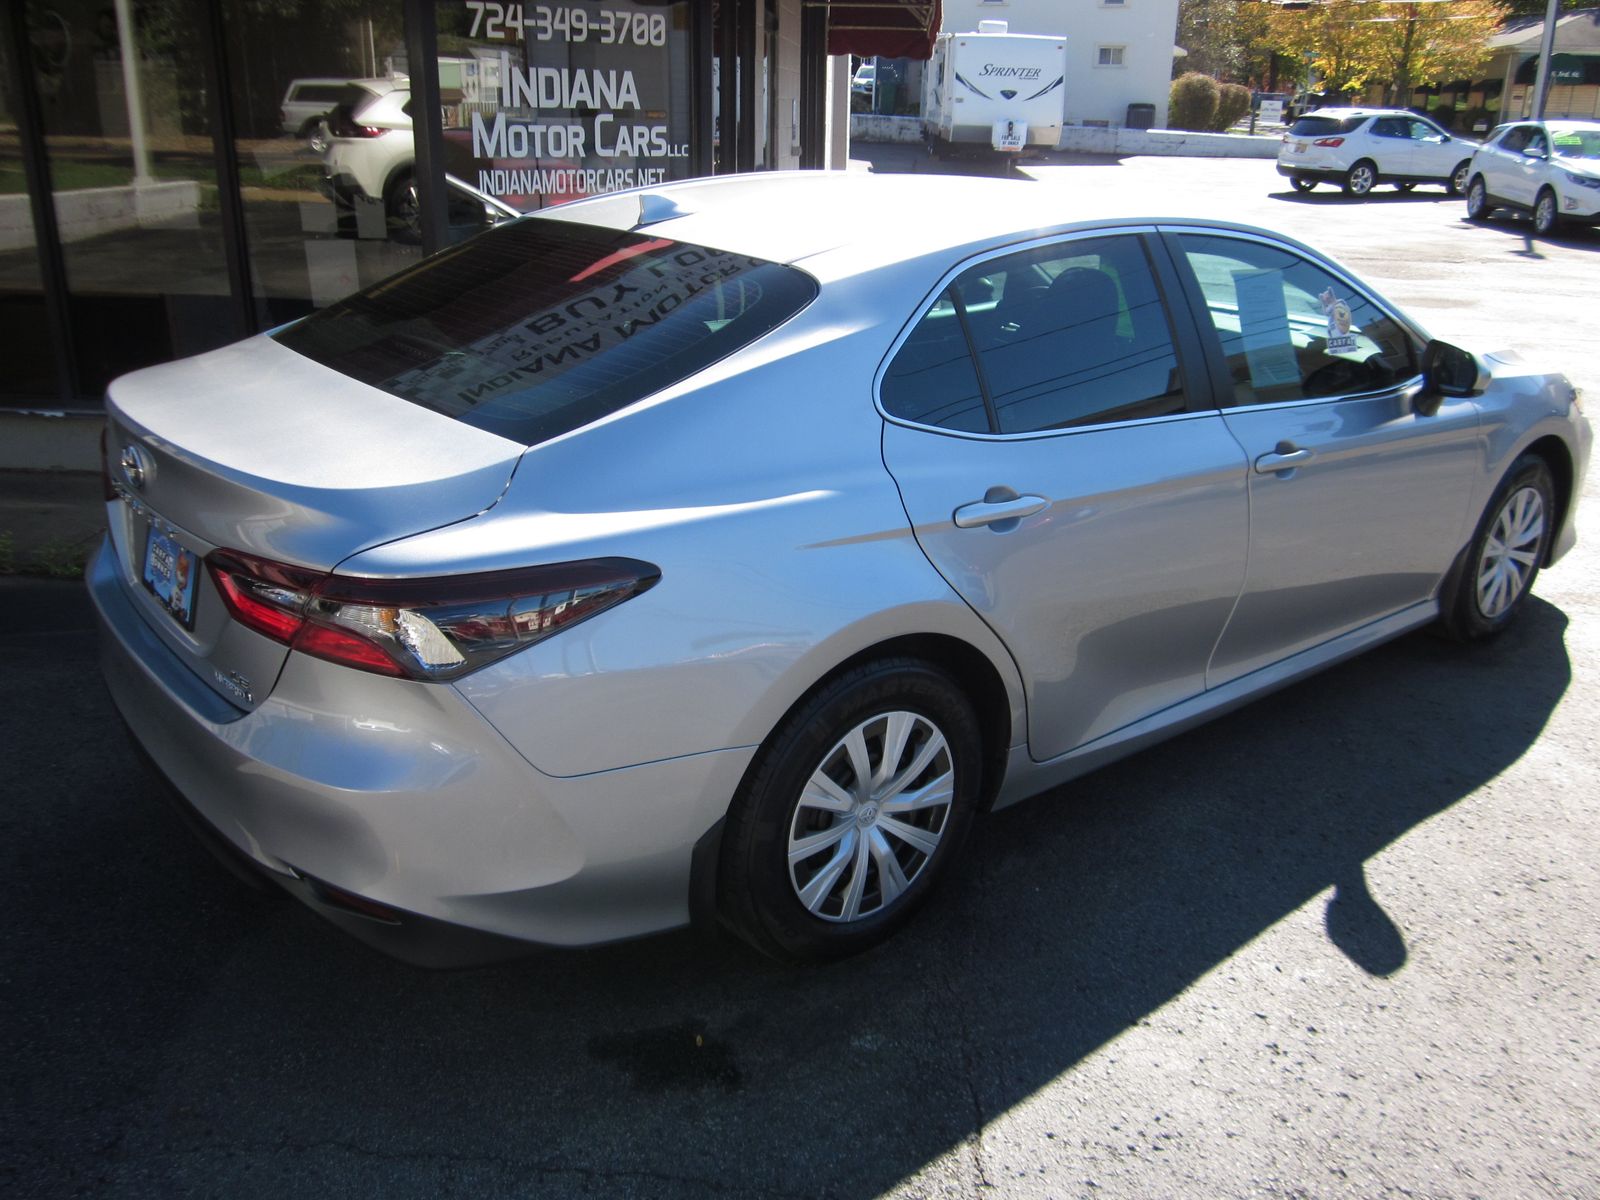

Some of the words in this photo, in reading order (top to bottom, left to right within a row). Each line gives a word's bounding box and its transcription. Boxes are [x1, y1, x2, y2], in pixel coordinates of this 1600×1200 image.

[466, 1, 666, 46] 724-349-3700
[501, 51, 641, 110] INDIANA
[979, 63, 1041, 77] SPRINTER
[472, 111, 586, 158] MOTOR
[595, 113, 667, 157] CARS
[479, 168, 665, 196] INDIANAMOTORCARSNET
